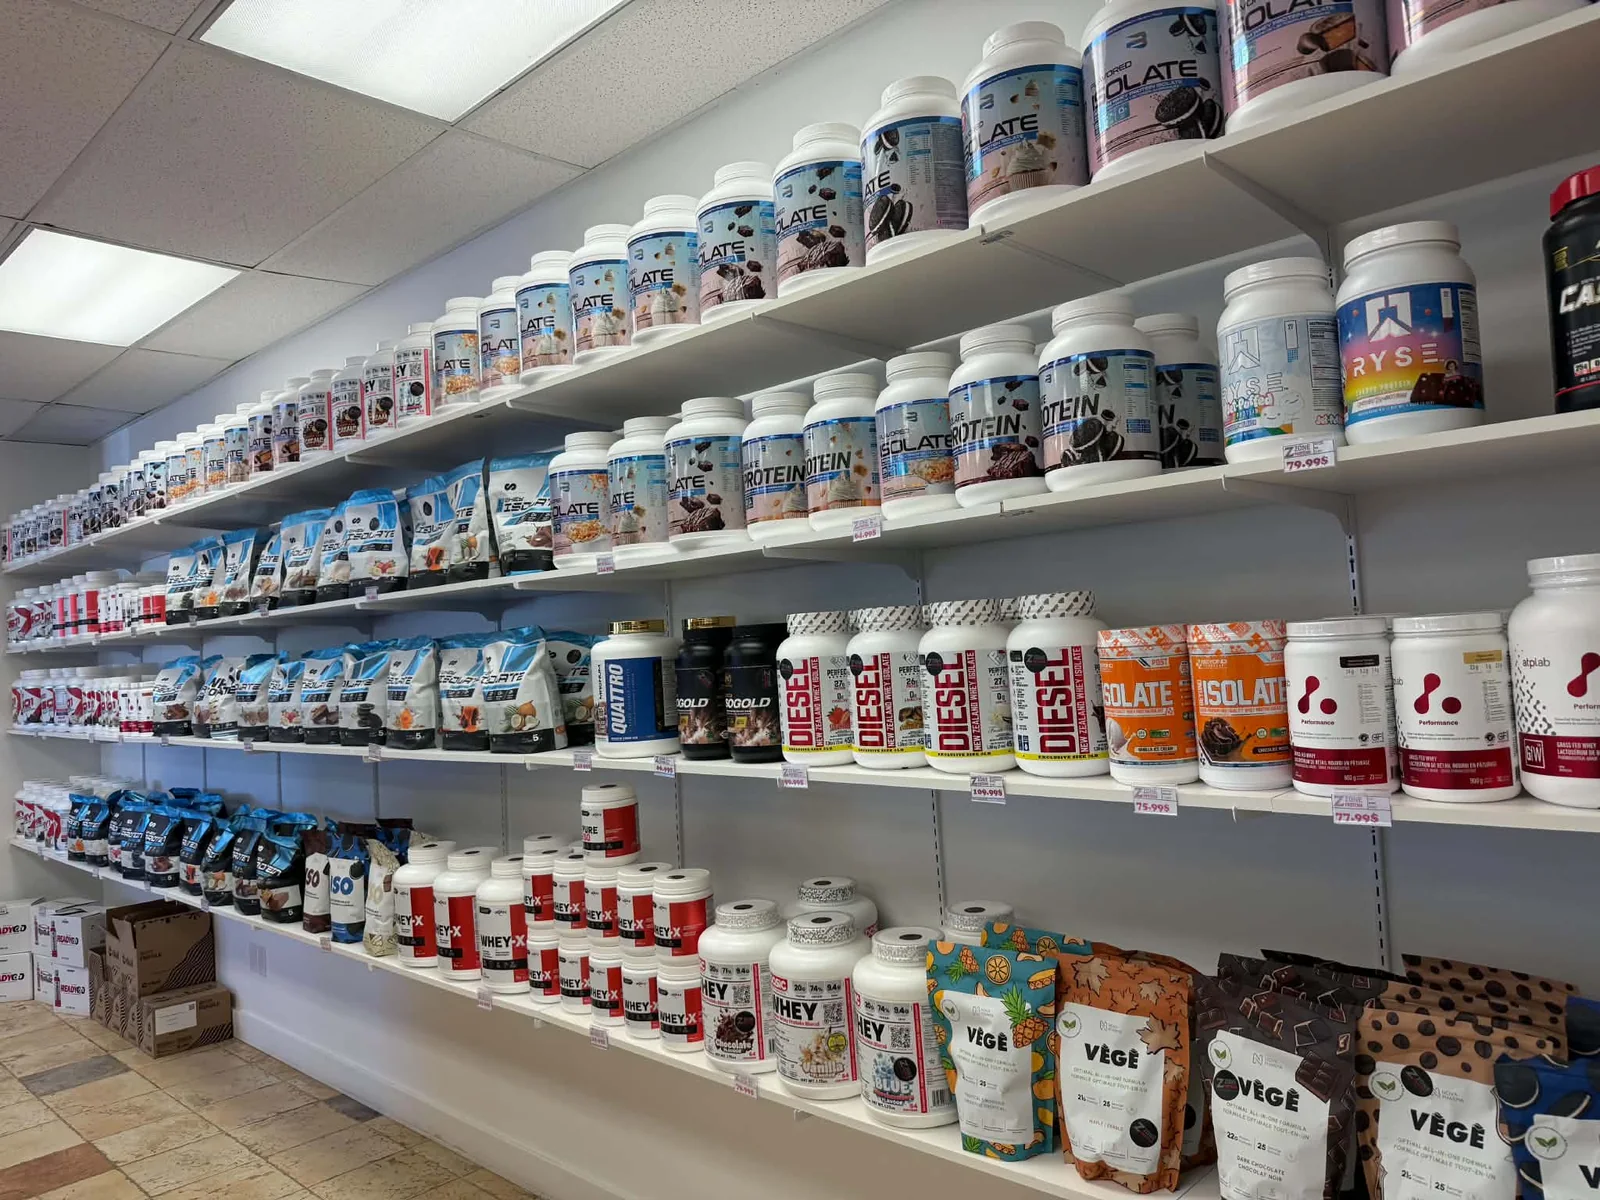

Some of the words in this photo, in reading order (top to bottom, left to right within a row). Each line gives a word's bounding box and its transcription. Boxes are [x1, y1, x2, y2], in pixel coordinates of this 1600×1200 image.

[1352, 343, 1438, 377] RYSE
[1286, 456, 1329, 470] 79.99$
[810, 657, 820, 684] ISOLATE
[881, 653, 891, 681] ISOLATE
[966, 650, 977, 680] ISOLATE
[1072, 647, 1083, 678] ISOLATE
[812, 685, 821, 701] WHEY
[883, 683, 893, 699] WHEY
[968, 682, 978, 700] WHEY
[1075, 680, 1085, 699] WHEY
[1202, 677, 1288, 706] ISOLATE
[608, 663, 628, 735] QUATTRO
[785, 658, 813, 746] DIESEL
[855, 655, 884, 747] DIESEL
[934, 652, 970, 751] DIESEL
[1034, 648, 1076, 753] DIESEL
[814, 702, 823, 731] ZEALAND
[885, 701, 895, 731] ZEALAND
[970, 701, 980, 733] ZEALAND
[1076, 700, 1088, 735] ZEALAND
[815, 733, 824, 747] NEW
[887, 732, 896, 747] NEW
[972, 735, 982, 751] NEW
[1080, 736, 1089, 753] NEW
[1556, 741, 1572, 749] GRASS
[1136, 802, 1170, 813] 75.99$
[1335, 812, 1379, 823] 77.99$
[330, 875, 354, 896] ISO
[480, 934, 526, 948] WHEY-X
[773, 994, 818, 1021] WHEY
[660, 1012, 697, 1025] WHEY-X
[714, 1037, 753, 1048] Chocolate
[801, 1061, 845, 1074] Vanilla
[874, 1078, 912, 1096] BLUE
[1256, 1142, 1267, 1151] 25
[1236, 1155, 1251, 1164] DARK
[1251, 1161, 1285, 1176] CHOCOLATE
[1238, 1163, 1267, 1177] CHOCOLAT
[1434, 1181, 1446, 1192] 25
